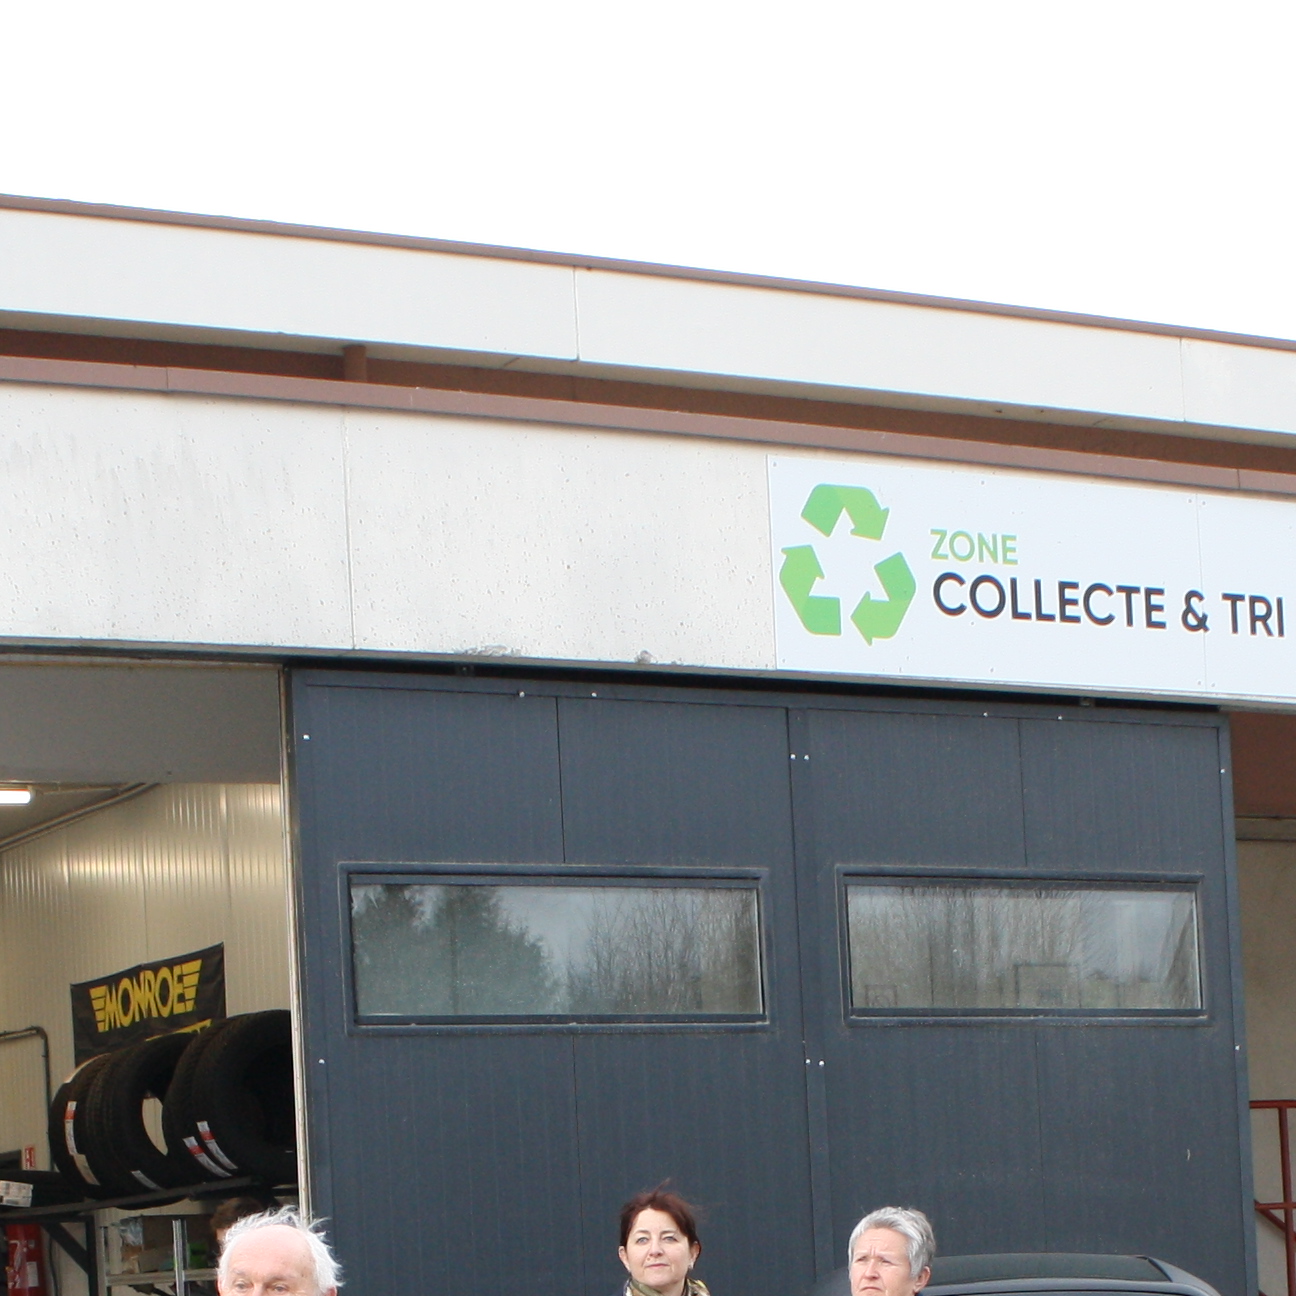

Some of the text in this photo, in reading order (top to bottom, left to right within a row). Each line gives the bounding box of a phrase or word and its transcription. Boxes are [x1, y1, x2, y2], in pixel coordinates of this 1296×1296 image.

[929, 527, 1019, 565] ZONE
[932, 571, 1167, 630] COLLECTE
[1180, 588, 1210, 634] &
[1221, 592, 1285, 638] TRI
[92, 960, 201, 1033] MONROE
